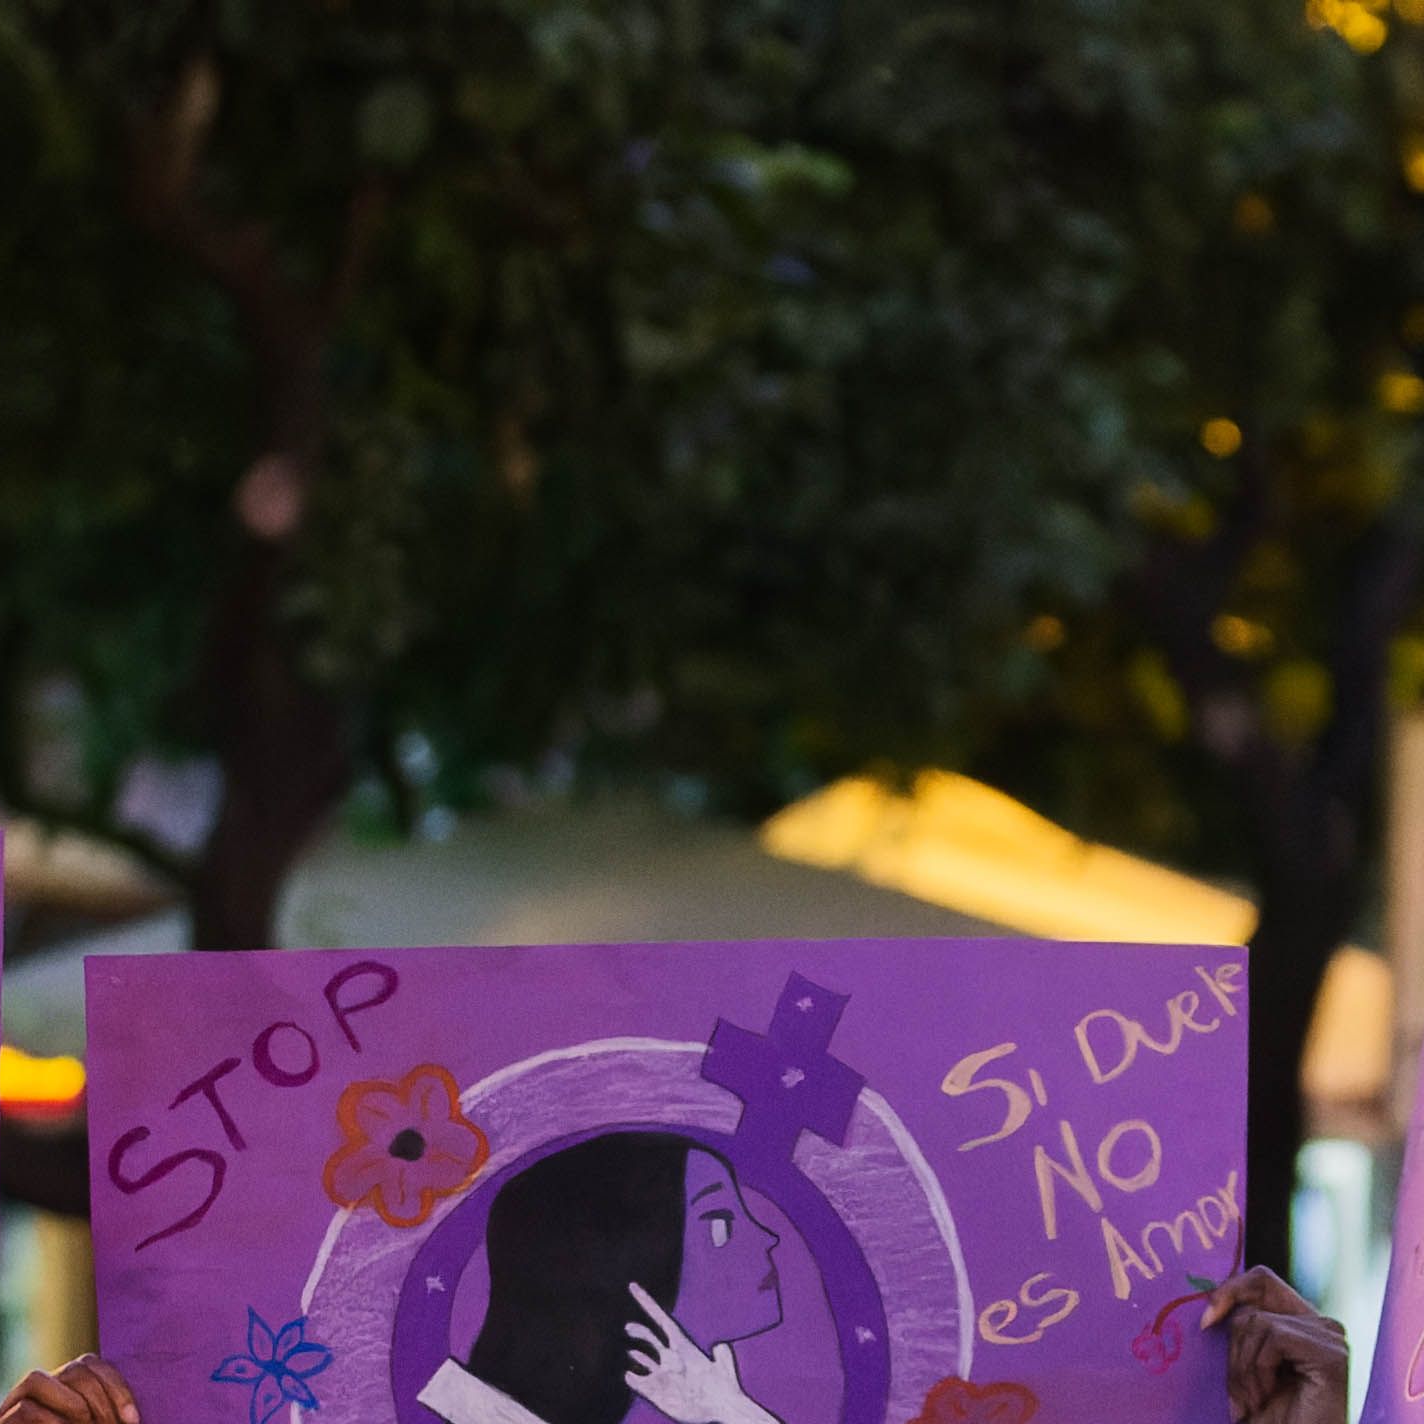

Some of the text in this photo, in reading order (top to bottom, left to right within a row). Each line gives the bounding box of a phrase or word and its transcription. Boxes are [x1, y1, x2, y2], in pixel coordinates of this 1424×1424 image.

[1074, 962, 1244, 1084] Duele
[108, 960, 399, 1252] STOP
[1034, 1119, 1162, 1241] NO
[978, 1170, 1240, 1344] es Amor
